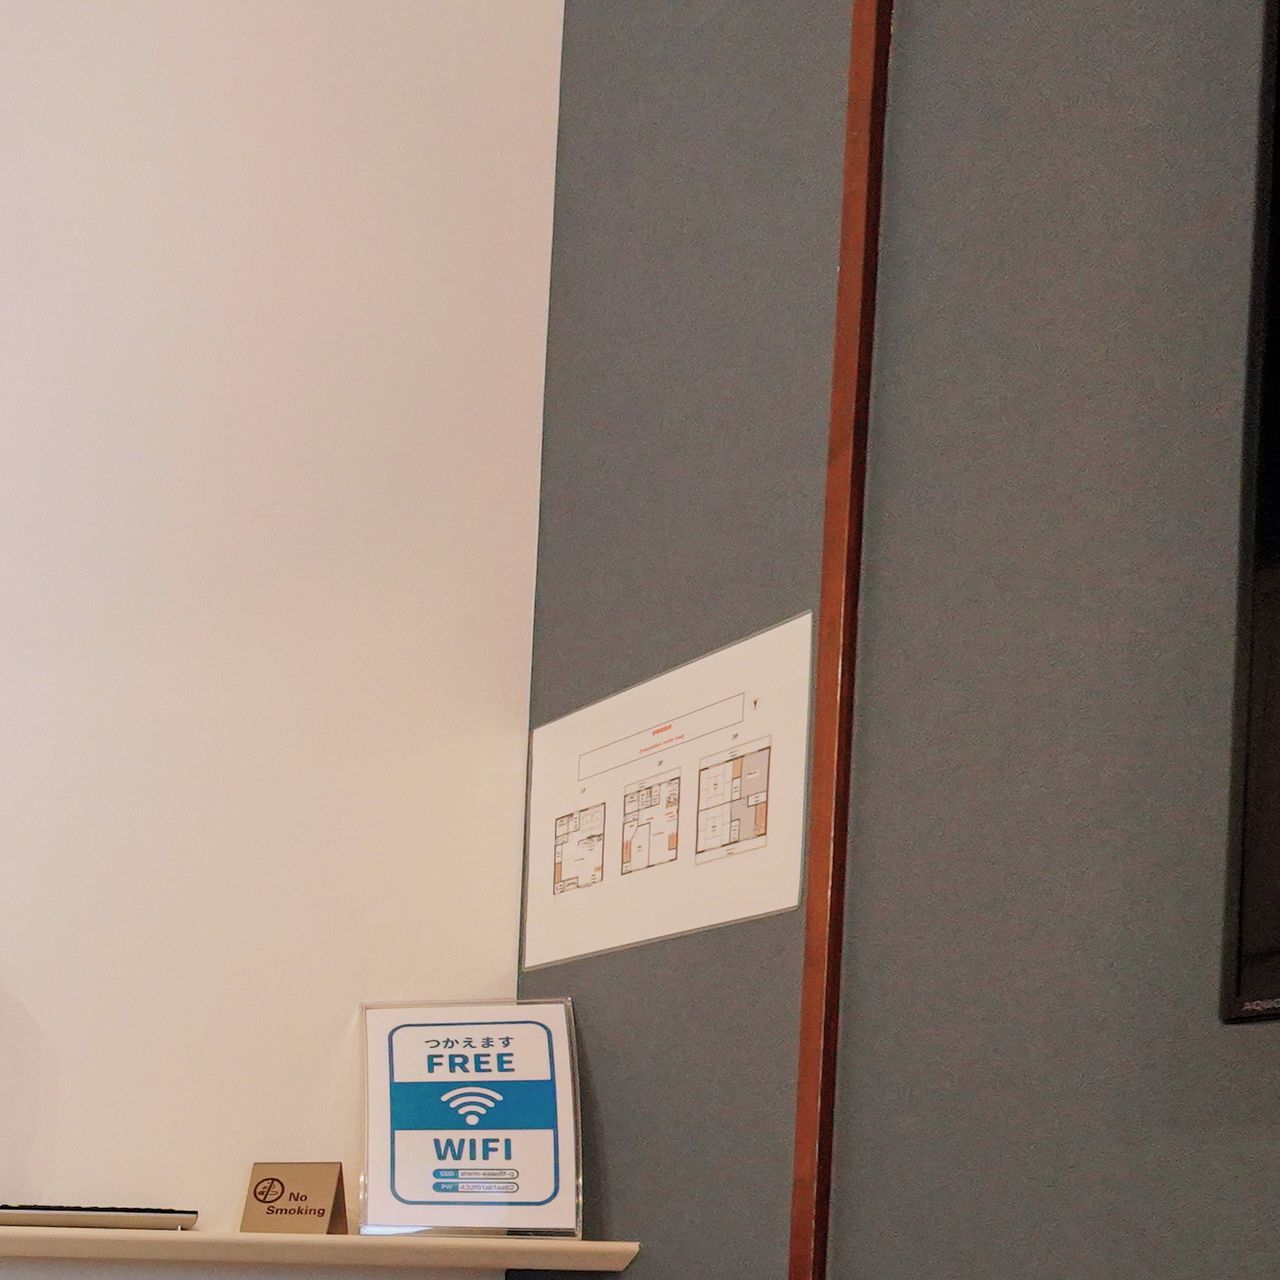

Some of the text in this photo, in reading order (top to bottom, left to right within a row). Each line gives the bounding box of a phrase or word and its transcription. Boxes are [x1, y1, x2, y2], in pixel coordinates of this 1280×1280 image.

[425, 1036, 515, 1050] つかえます
[427, 1053, 516, 1074] FREE
[433, 1138, 513, 1161] WIFI
[288, 1192, 308, 1202] No
[266, 1205, 327, 1218] Smoking
